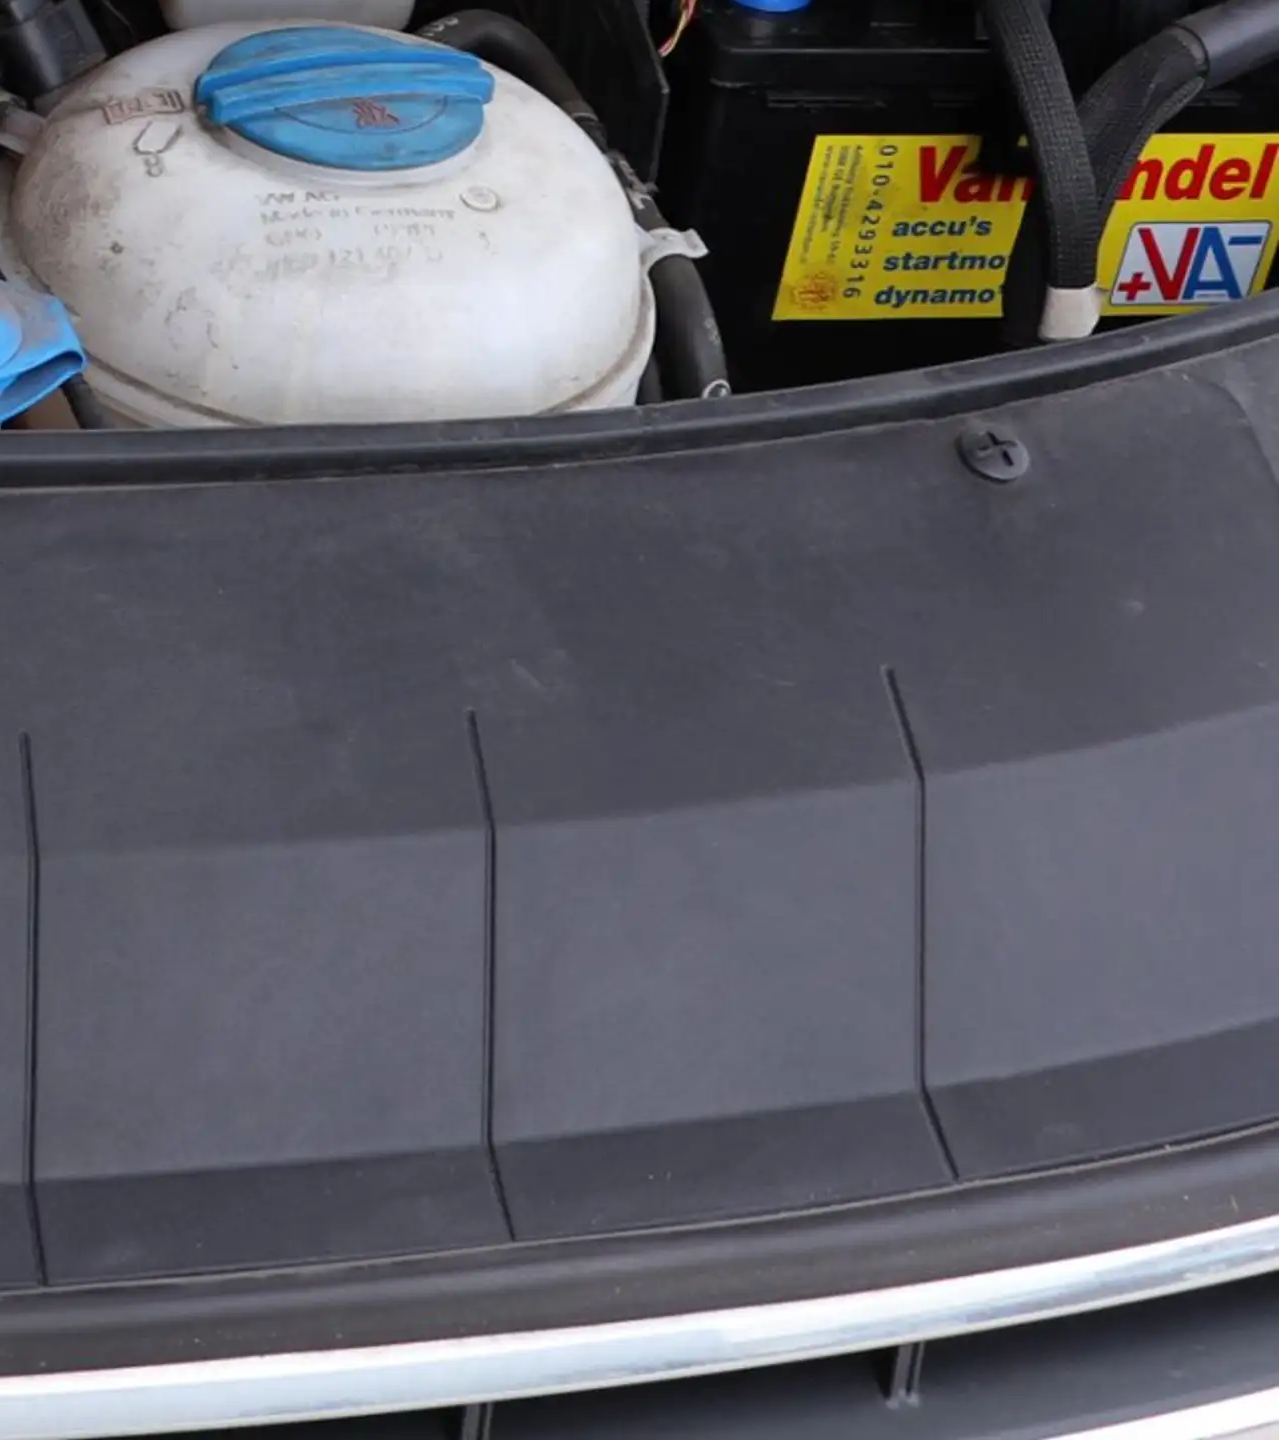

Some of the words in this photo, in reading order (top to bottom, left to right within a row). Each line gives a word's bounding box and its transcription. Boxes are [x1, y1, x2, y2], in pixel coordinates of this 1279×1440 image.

[1114, 143, 1279, 202] ndel
[842, 144, 899, 301] 010-4293316
[891, 215, 994, 238] accu's
[882, 251, 1007, 273] startmo
